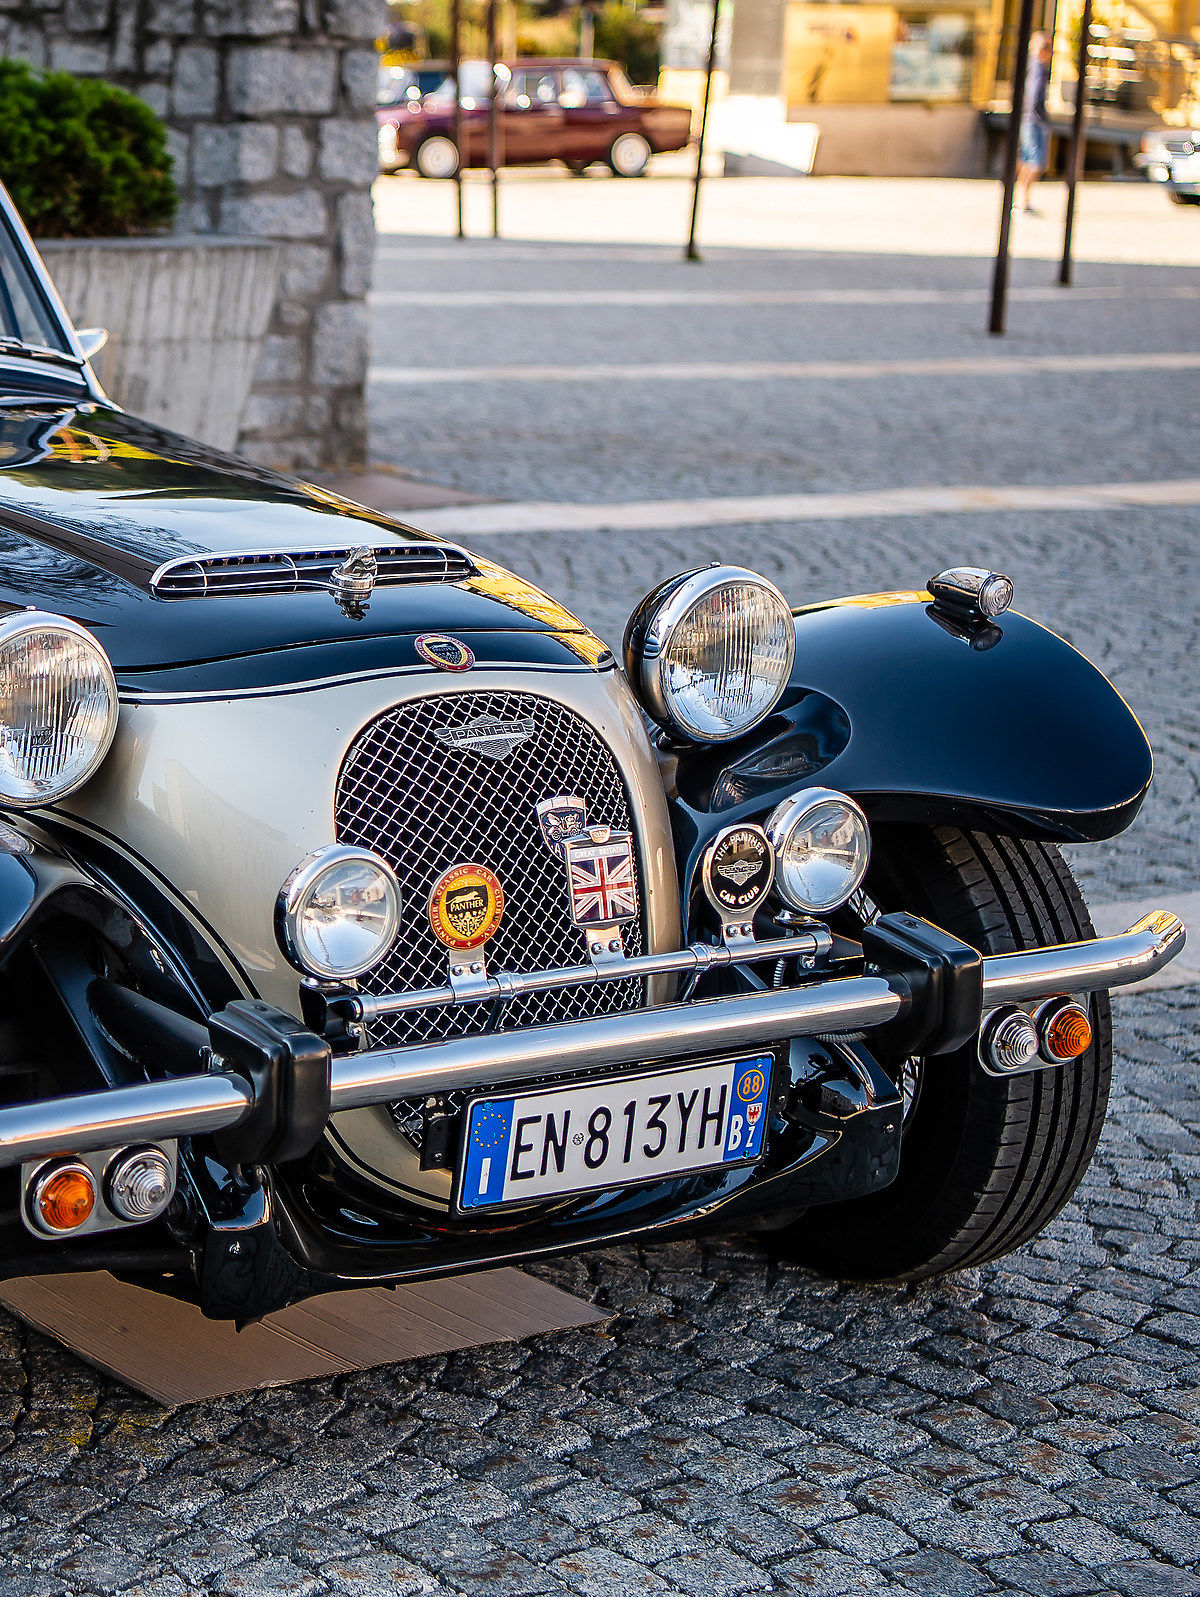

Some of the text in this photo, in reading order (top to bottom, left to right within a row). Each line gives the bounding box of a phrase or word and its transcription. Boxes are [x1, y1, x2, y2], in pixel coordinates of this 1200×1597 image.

[455, 724, 522, 740] PANTHER
[574, 849, 596, 859] GREAT
[714, 831, 765, 861] THE PANTHER
[436, 867, 469, 896] CLASSIC
[476, 868, 493, 883] CAR
[719, 885, 760, 905] CAR CLUB
[450, 899, 484, 912] PANTHER
[742, 1075, 761, 1095] 88
[509, 1083, 728, 1181] EN 813YH
[478, 1157, 492, 1195] I
